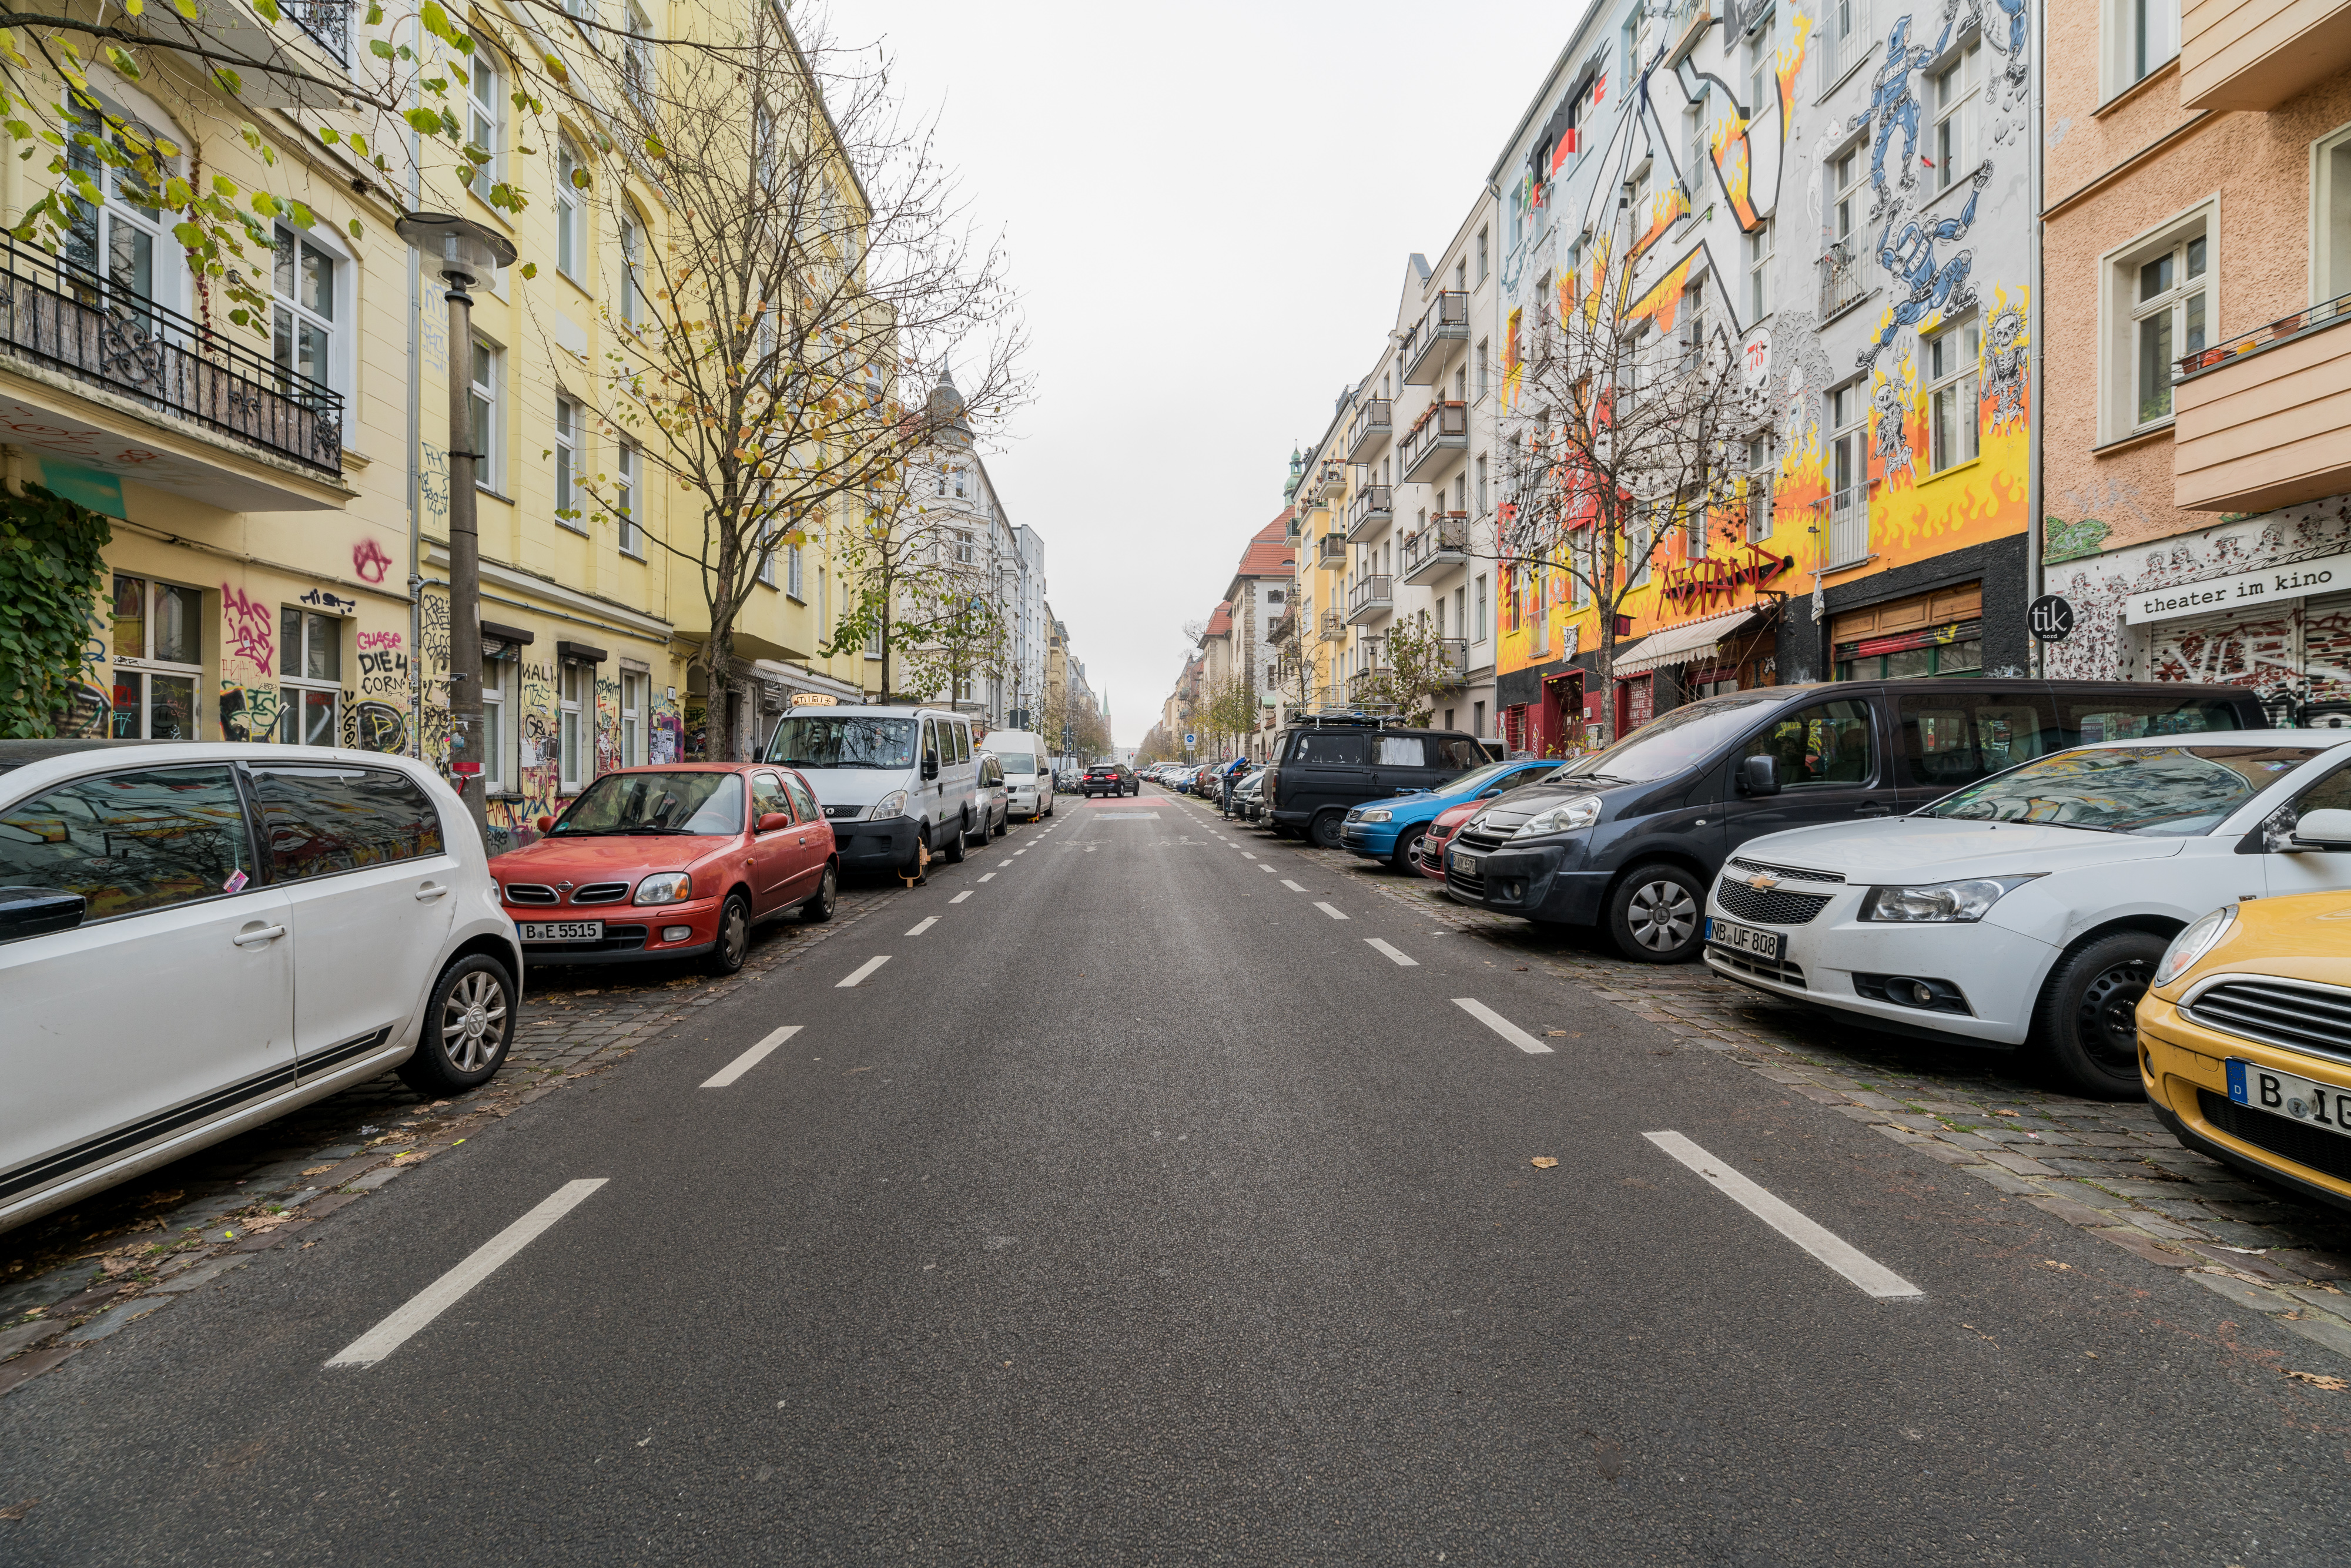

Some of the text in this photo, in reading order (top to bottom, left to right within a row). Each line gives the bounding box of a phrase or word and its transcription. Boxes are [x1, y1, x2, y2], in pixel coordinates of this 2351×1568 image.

[1747, 340, 1763, 371] 78
[1656, 542, 1784, 621] ABSTAND
[2144, 571, 2332, 614] theater im kino
[2032, 599, 2068, 632] tik
[359, 651, 408, 679] DIE 4
[1632, 689, 1646, 699] THREE
[1632, 699, 1645, 709] MAKE
[1454, 855, 1456, 867] B
[527, 923, 597, 939] B E 5515
[1712, 921, 1775, 955] NB UF 808
[2235, 1085, 2241, 1094] D
[2259, 1072, 2282, 1108] B
